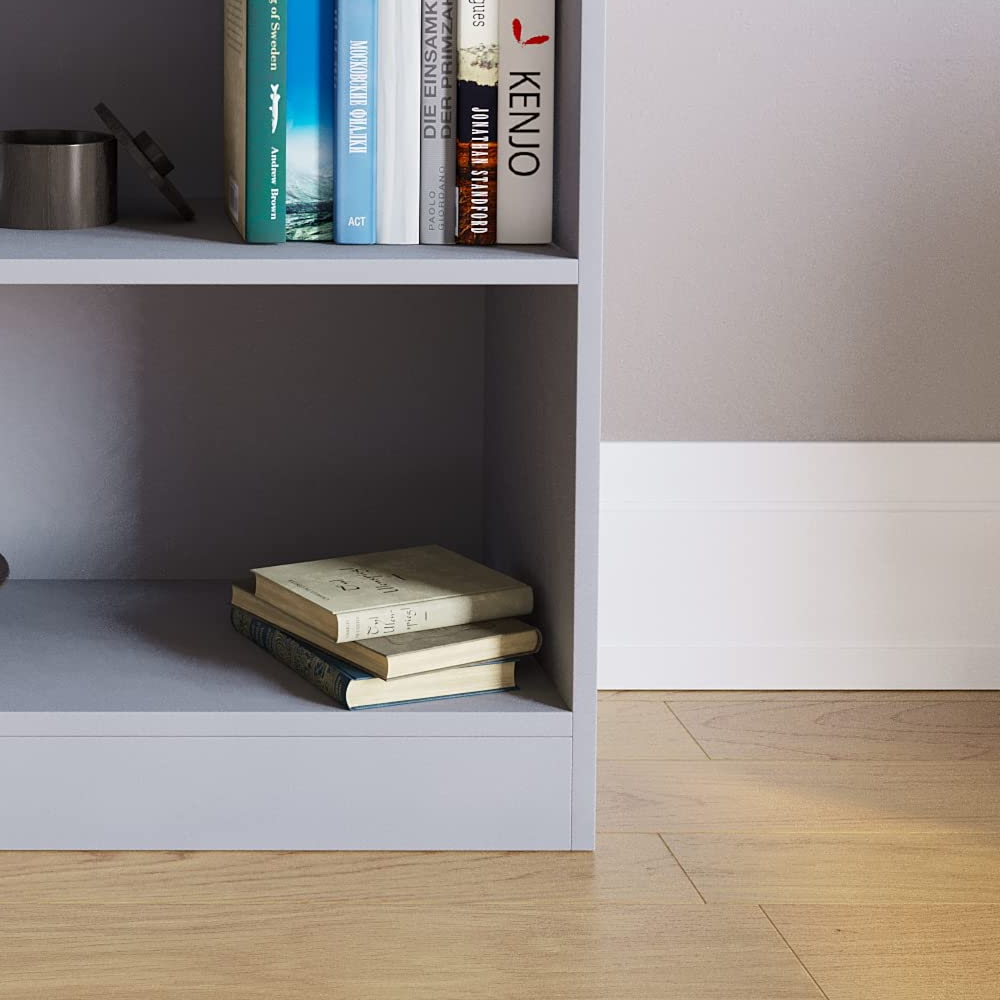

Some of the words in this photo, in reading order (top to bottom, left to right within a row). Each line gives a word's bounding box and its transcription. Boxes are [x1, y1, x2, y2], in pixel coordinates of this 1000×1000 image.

[270, 6, 280, 20] of
[270, 22, 280, 71] Sweden
[349, 39, 368, 106] МОСКОВСКИЕ
[349, 108, 367, 153] ФИАЛКИ
[423, 104, 437, 139] DIE
[441, 97, 453, 139] DER
[471, 106, 489, 164] JONATHAN
[508, 71, 541, 176] KENJO
[270, 146, 279, 185] Andrew
[270, 188, 279, 220] Brown
[428, 191, 436, 231] PAOLO
[438, 166, 446, 231] GIORDANO
[470, 170, 489, 234] STANDFORD
